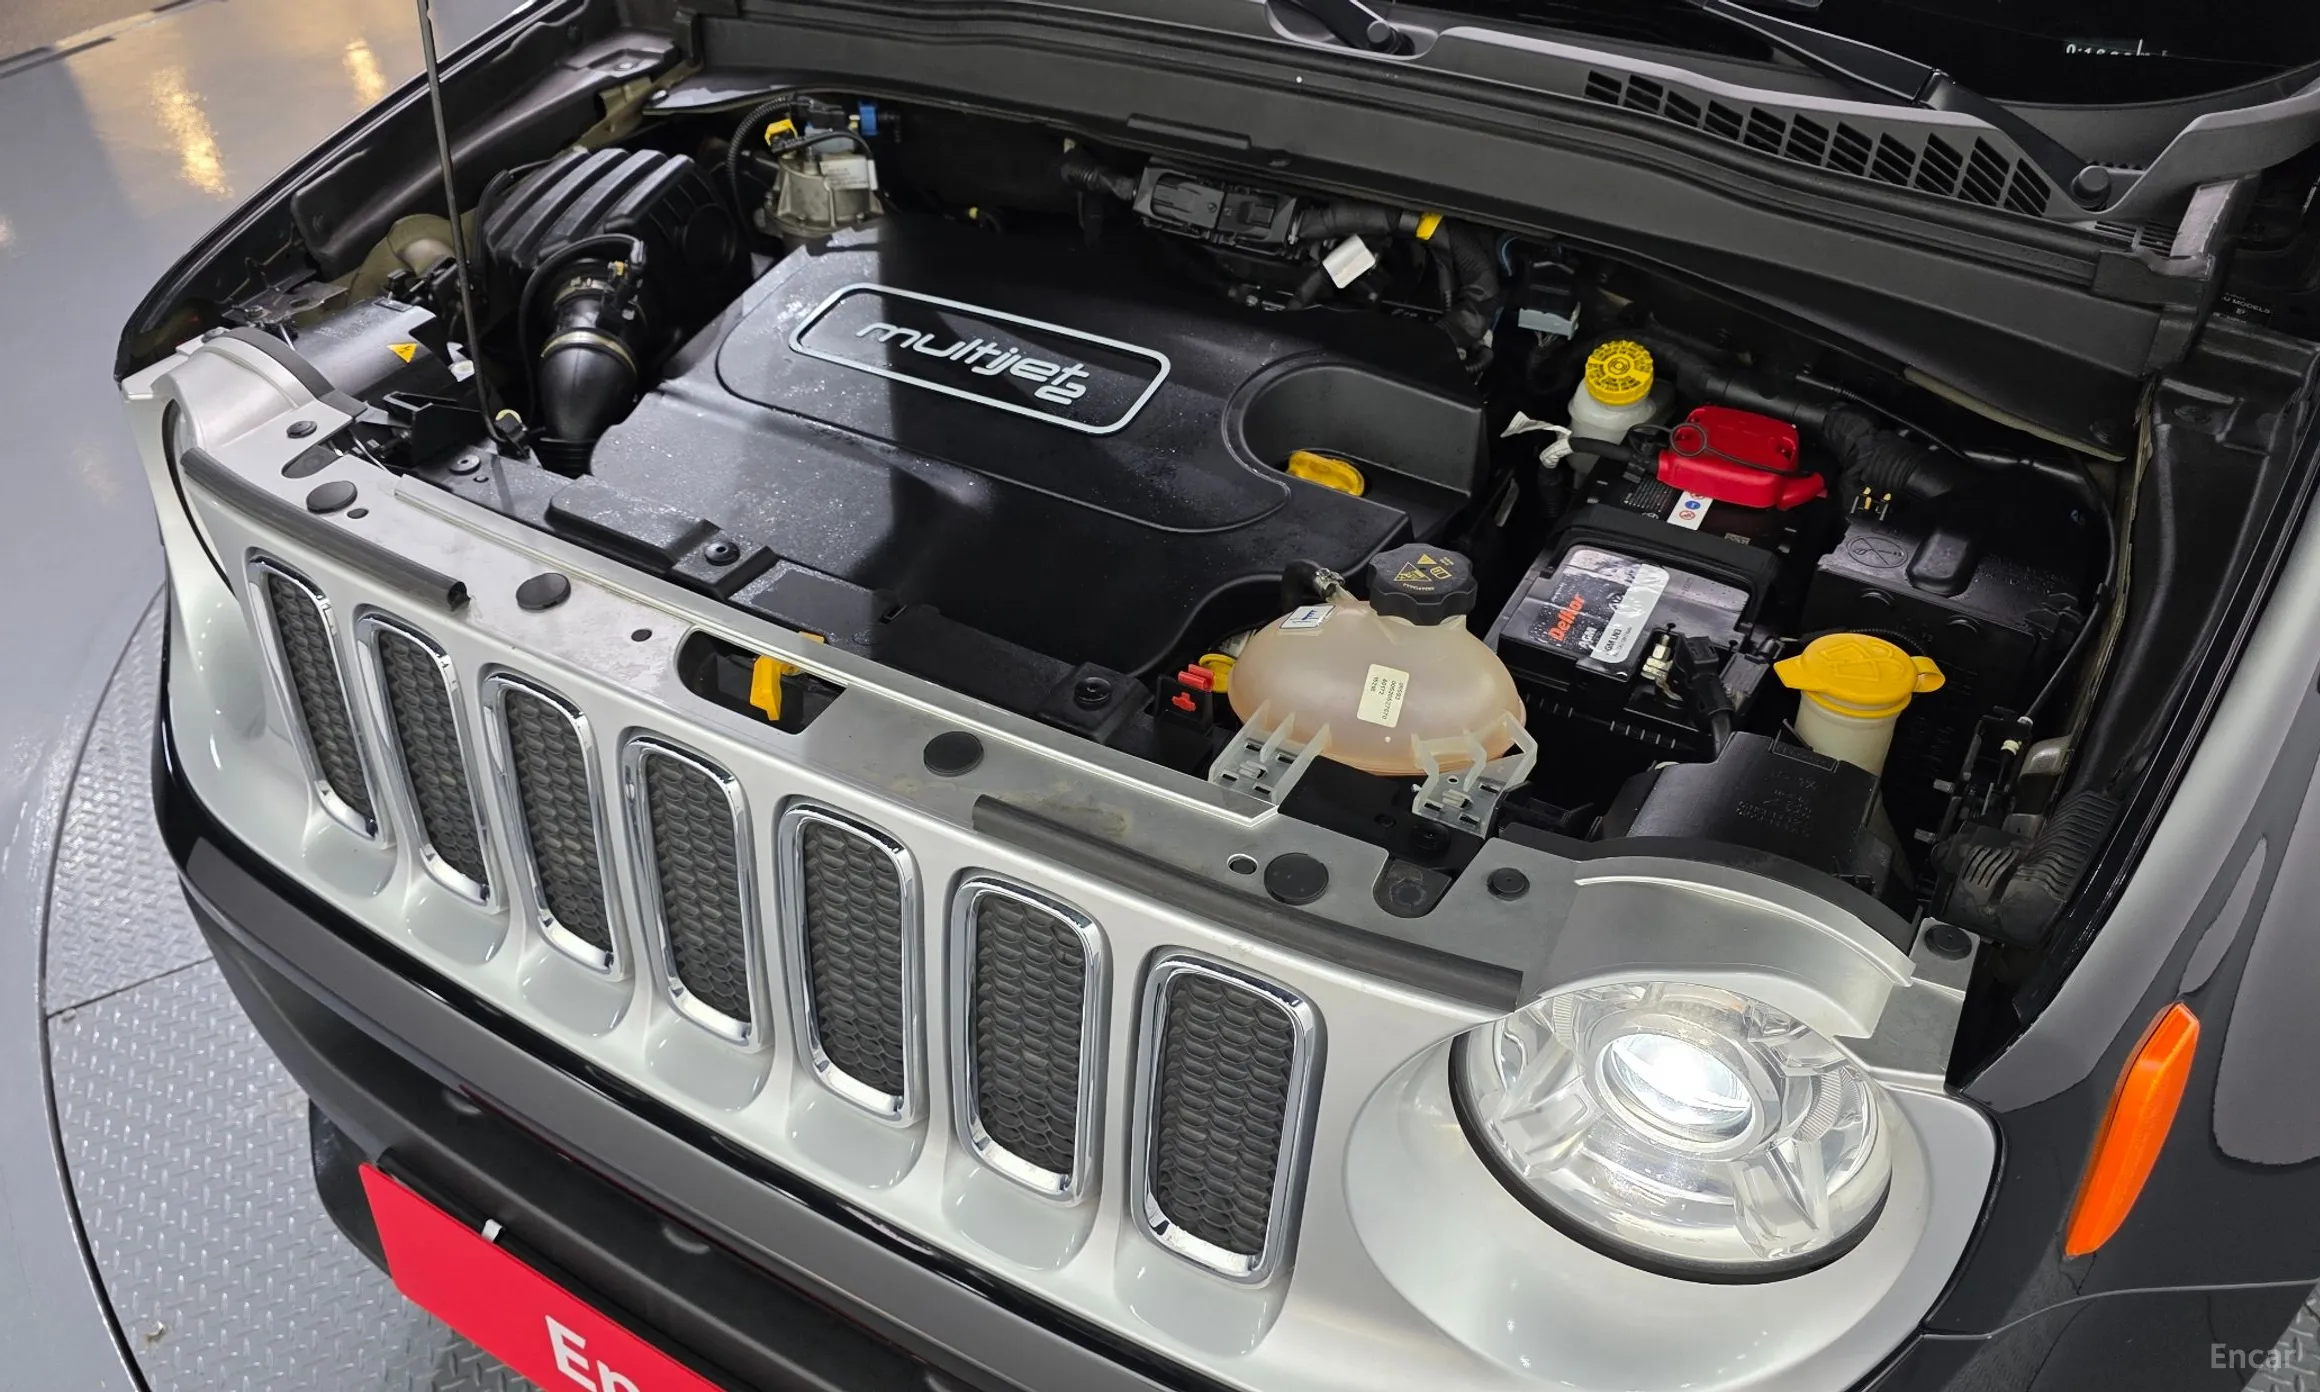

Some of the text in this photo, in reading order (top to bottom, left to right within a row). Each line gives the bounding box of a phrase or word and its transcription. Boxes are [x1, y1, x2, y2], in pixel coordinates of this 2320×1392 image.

[856, 322, 1090, 386] multijet
[1547, 592, 1585, 641] Delkor
[1578, 626, 1597, 649] AGM
